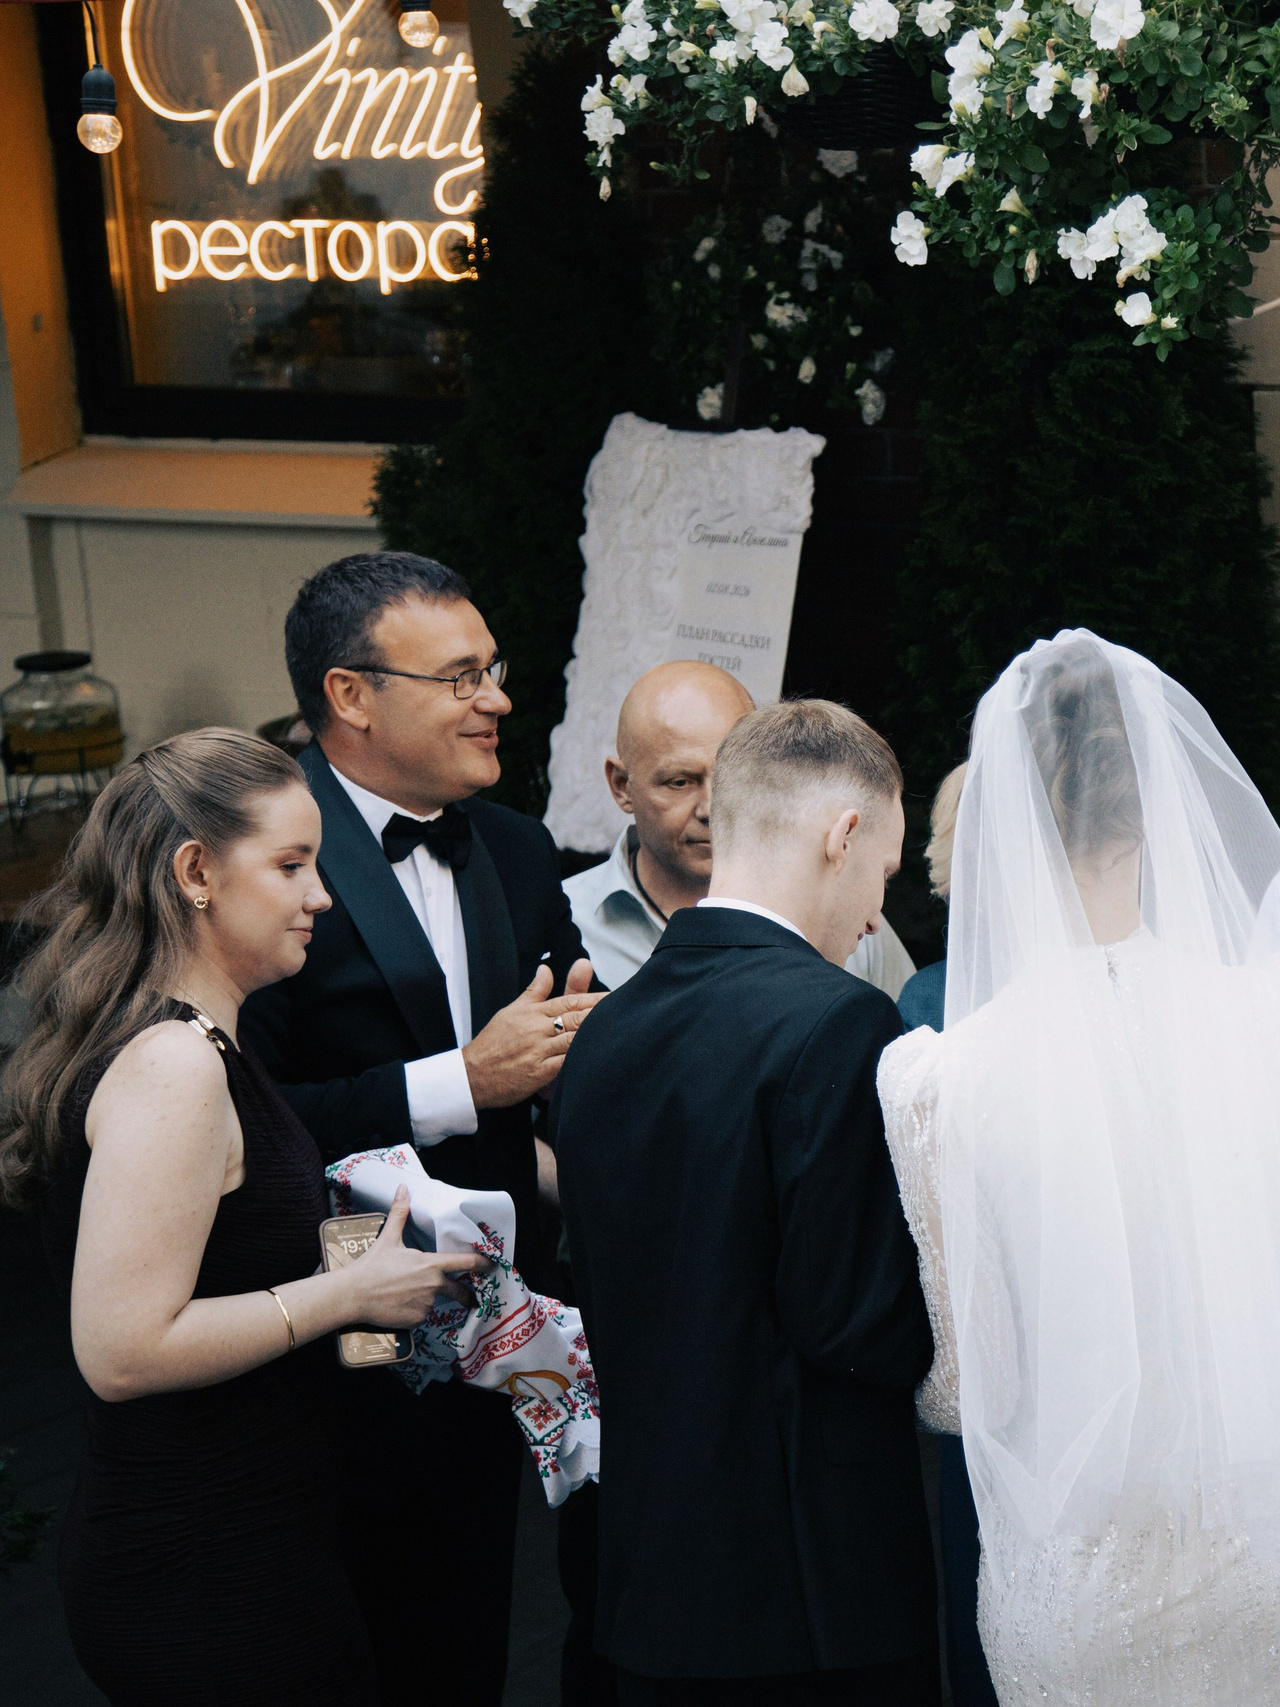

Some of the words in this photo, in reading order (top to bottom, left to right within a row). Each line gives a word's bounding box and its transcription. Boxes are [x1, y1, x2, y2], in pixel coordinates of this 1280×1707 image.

[151, 219, 489, 295] рестора
[676, 623, 710, 641] ПЛАН
[710, 628, 771, 650] РАССАДКИ
